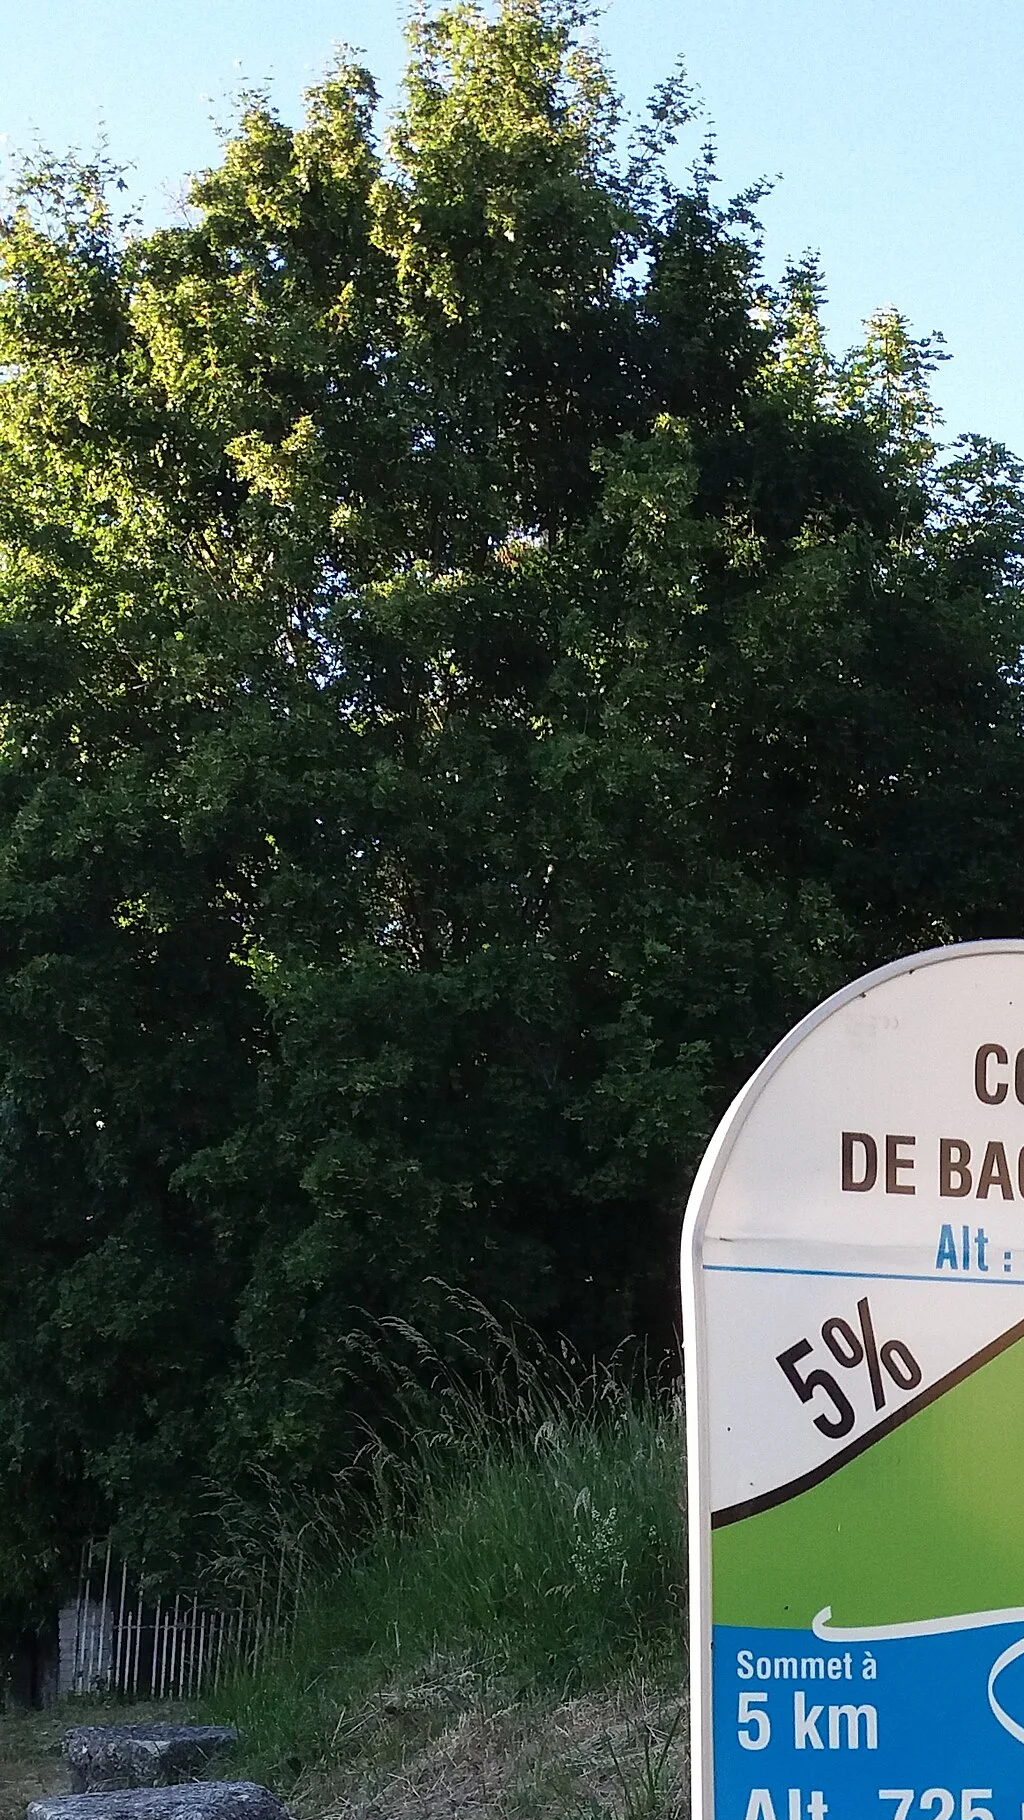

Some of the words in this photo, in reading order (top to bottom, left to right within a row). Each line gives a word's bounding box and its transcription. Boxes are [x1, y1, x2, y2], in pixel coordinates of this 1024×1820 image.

[841, 1131, 916, 1196] DE
[935, 1224, 989, 1272] Alt
[775, 1296, 923, 1440] 5%
[737, 1650, 853, 1680] Sommet
[862, 1651, 877, 1680] à
[737, 1692, 771, 1751] 5
[794, 1691, 878, 1750] km
